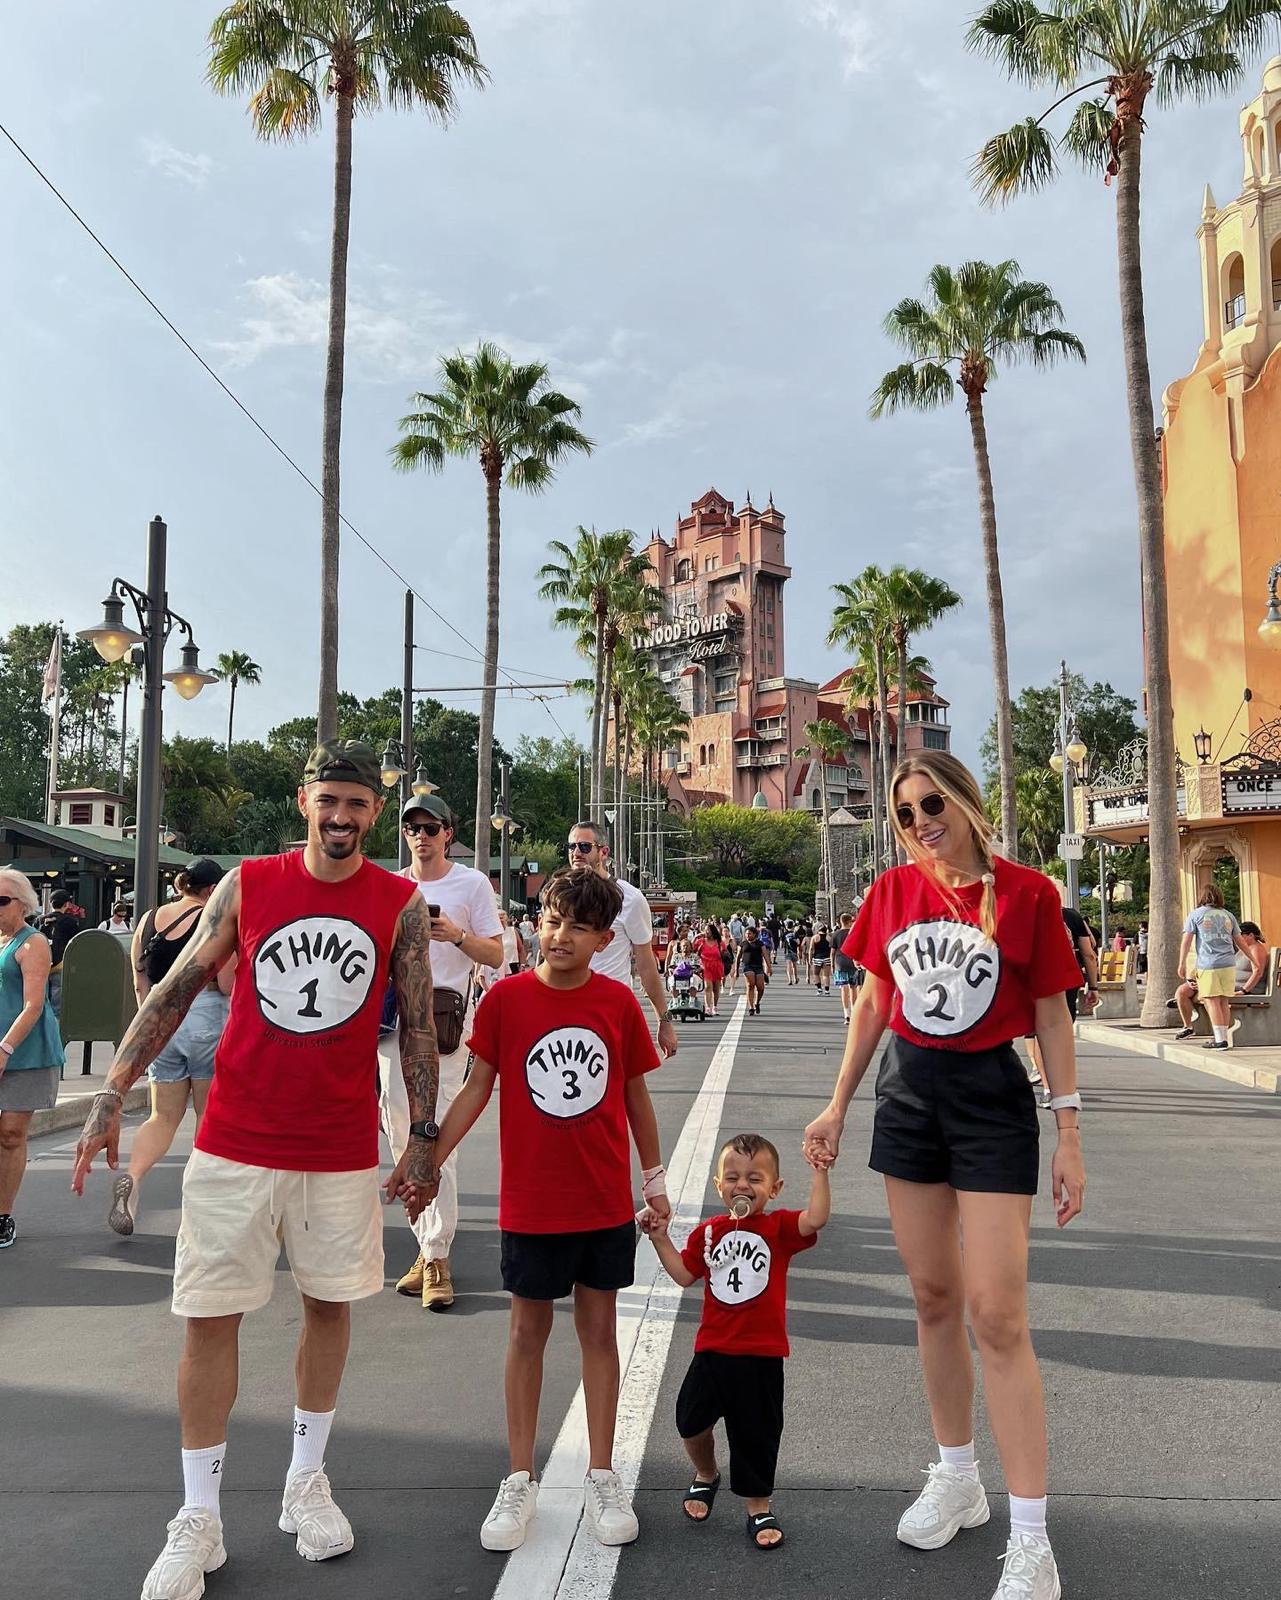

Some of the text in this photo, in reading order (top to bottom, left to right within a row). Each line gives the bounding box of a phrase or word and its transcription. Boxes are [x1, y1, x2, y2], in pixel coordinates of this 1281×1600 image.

[685, 612, 728, 638] TOWER
[689, 635, 726, 660] Hotel
[1236, 780, 1274, 793] ONCE
[1065, 838, 1080, 846] TAXI
[260, 931, 368, 984] THING
[890, 935, 993, 989] THING
[297, 977, 323, 1018] 1
[923, 983, 956, 1021] 2
[528, 1039, 604, 1079] THING
[561, 1069, 582, 1100] 3
[726, 1266, 744, 1293] 4
